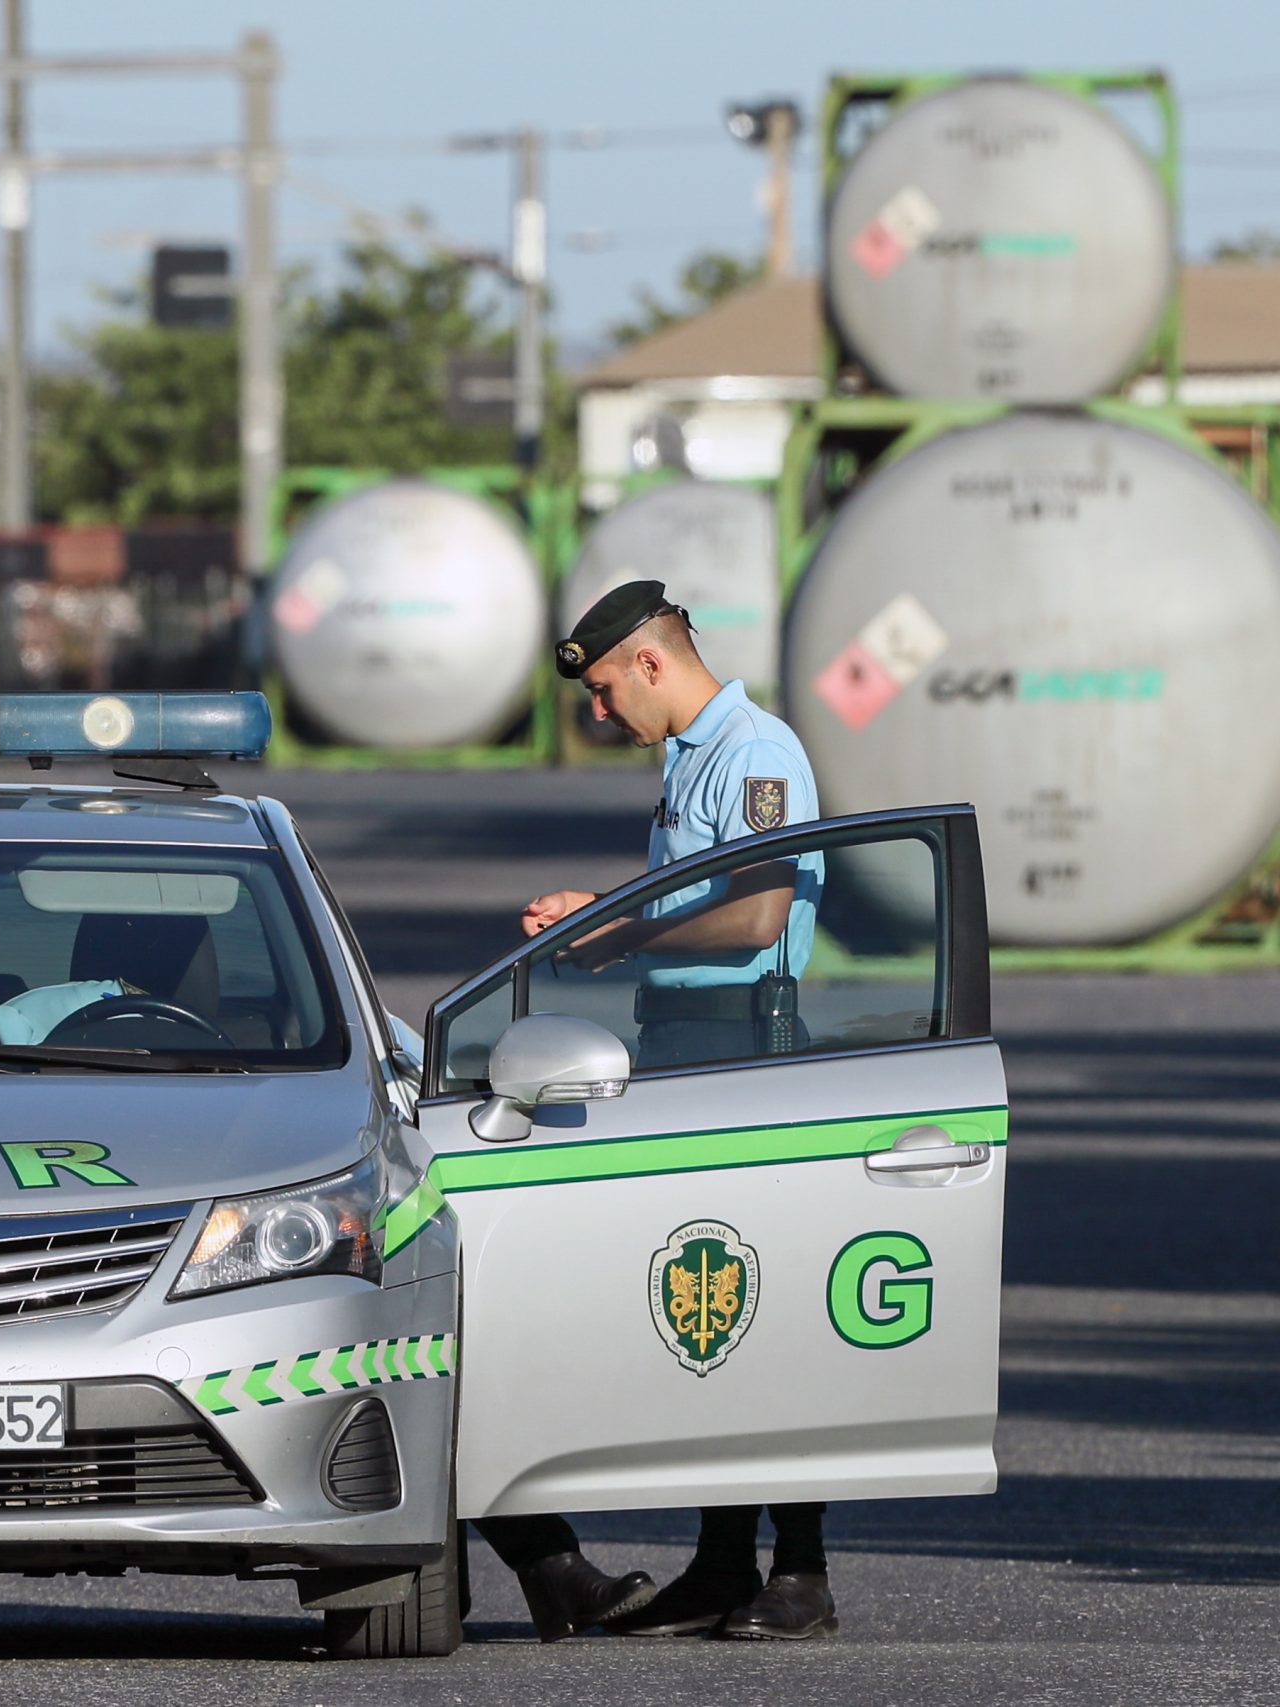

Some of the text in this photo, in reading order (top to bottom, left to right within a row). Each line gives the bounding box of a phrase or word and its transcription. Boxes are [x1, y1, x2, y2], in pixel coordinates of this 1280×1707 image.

[651, 1227, 758, 1330] GUARDA NACIONAL REPUBLICANA
[826, 1230, 933, 1350] G
